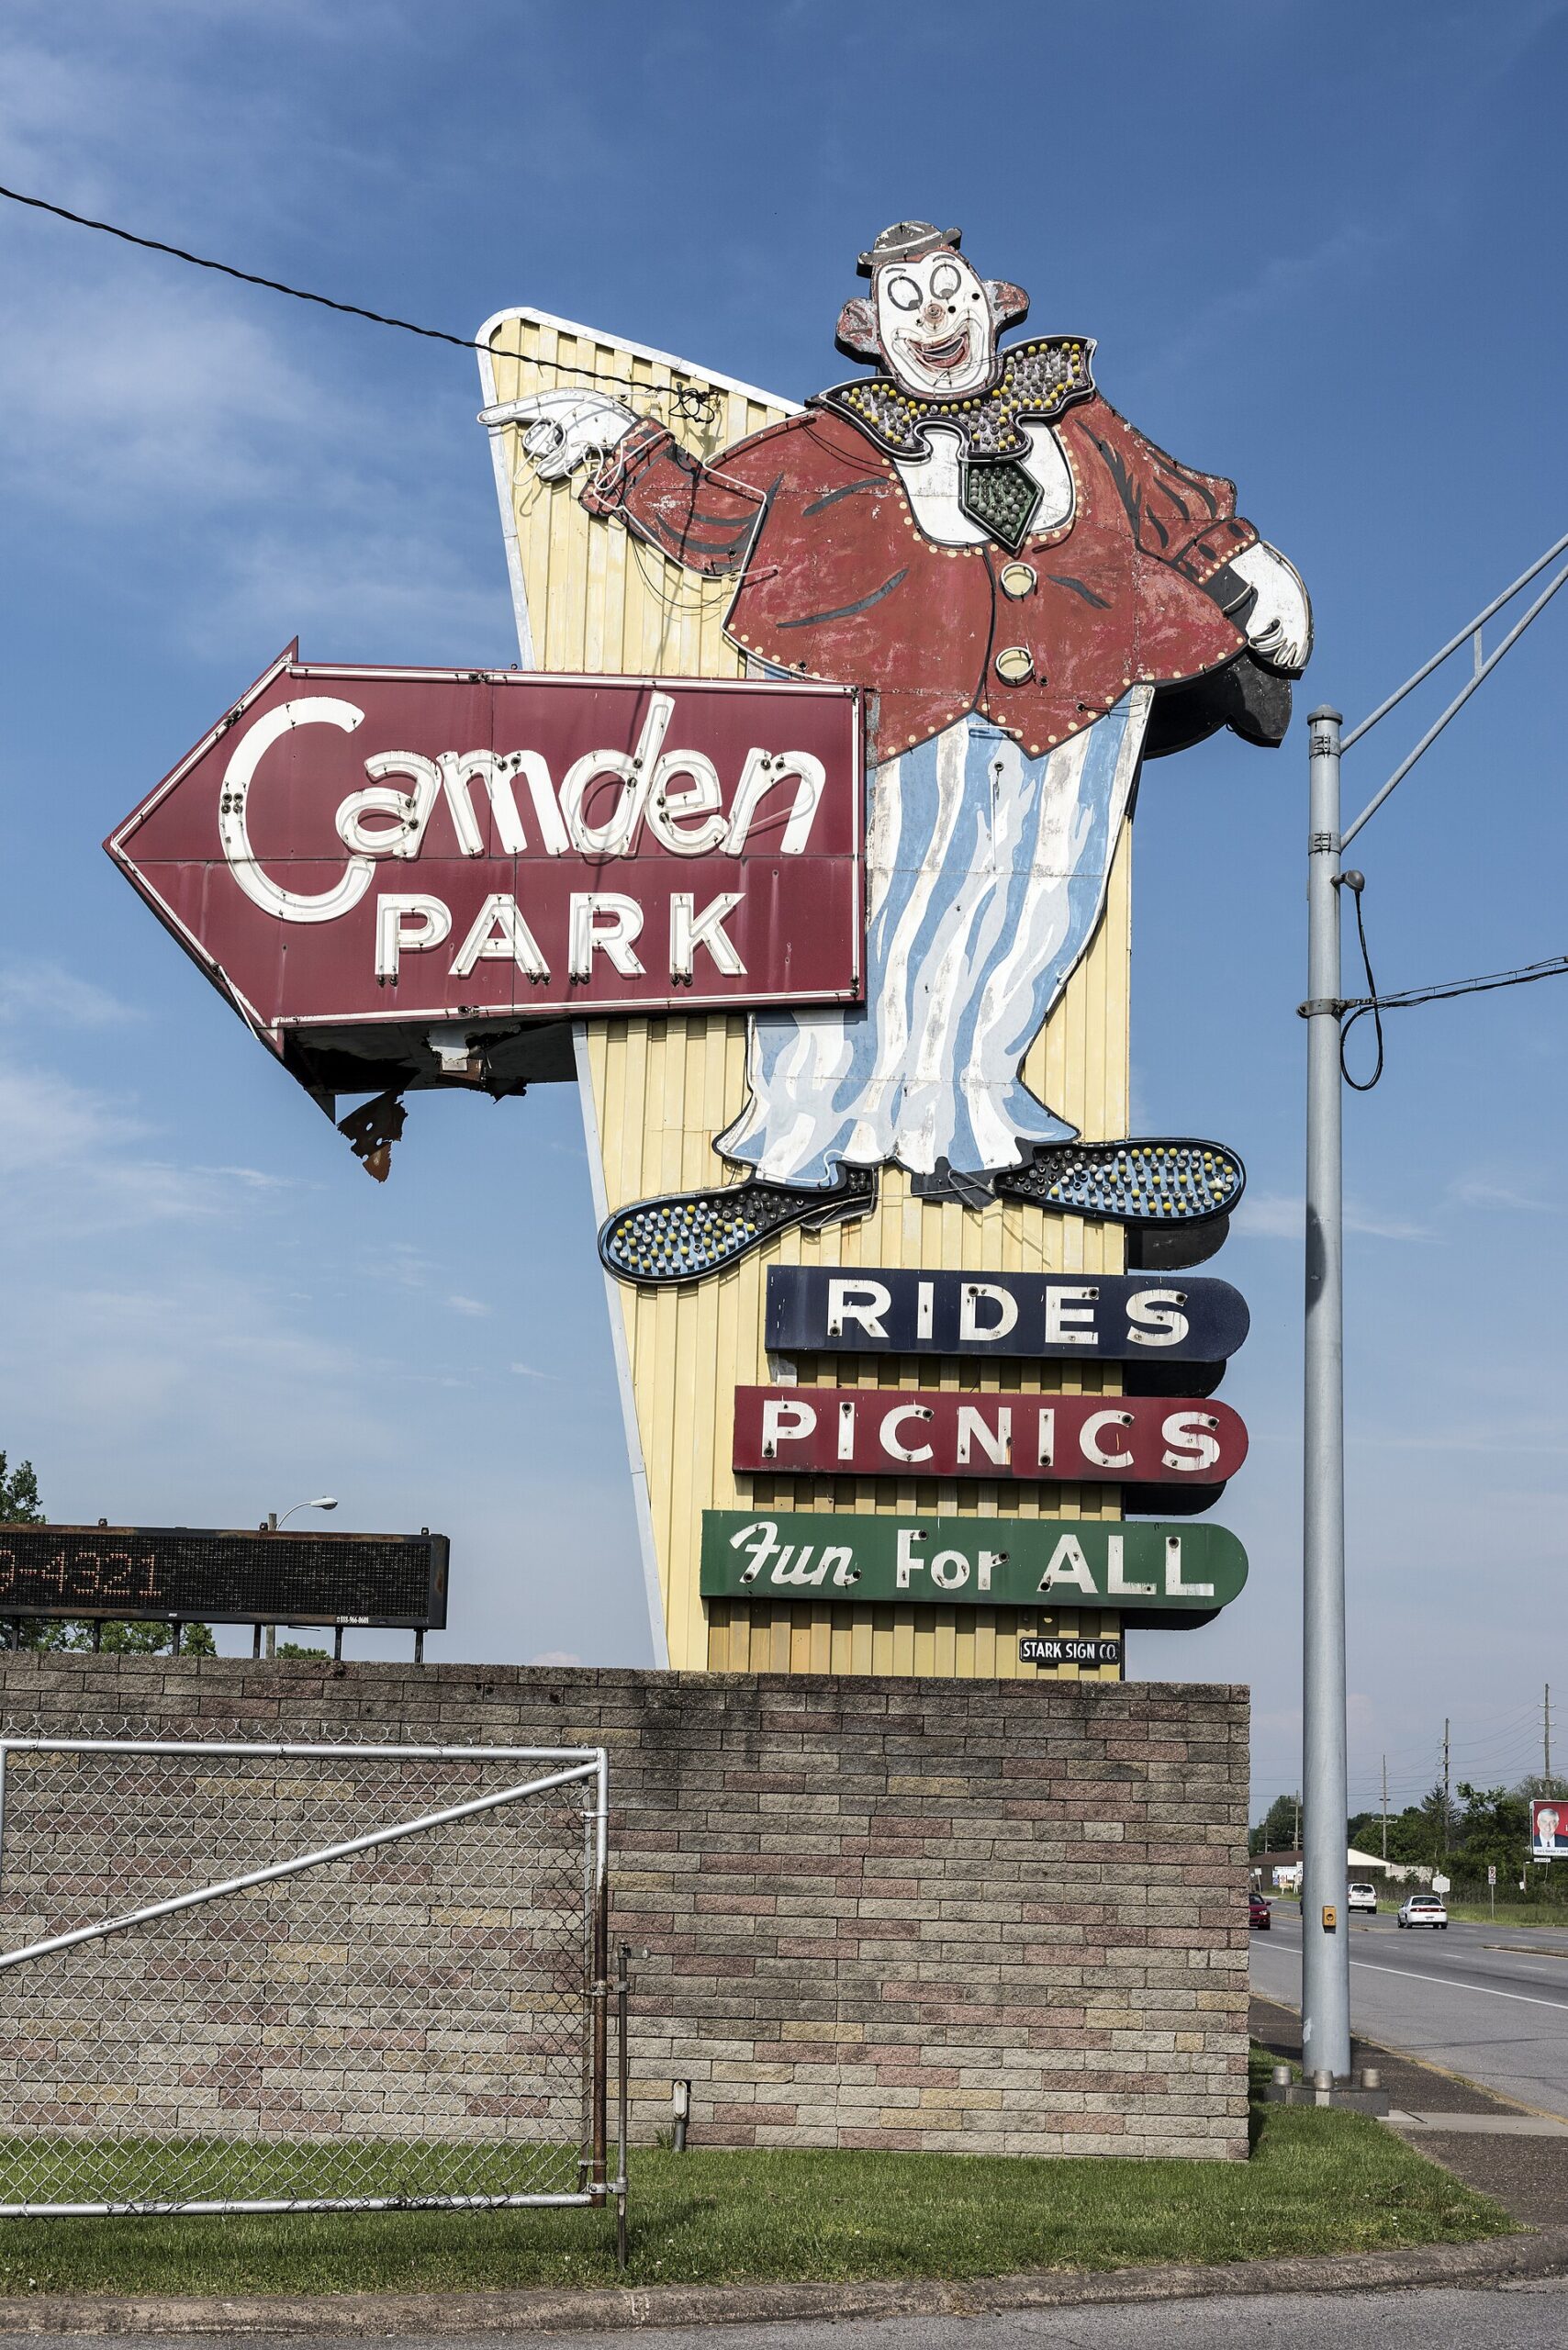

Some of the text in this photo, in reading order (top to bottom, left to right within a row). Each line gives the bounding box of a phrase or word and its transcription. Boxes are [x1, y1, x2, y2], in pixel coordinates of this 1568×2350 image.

[219, 690, 827, 923] Camden
[375, 892, 747, 978] PARK
[827, 1278, 1190, 1348] RIDES
[761, 1400, 1221, 1472] PICNICS
[729, 1520, 1215, 1597] Fun For ALL
[1023, 1641, 1062, 1658] STARK
[1065, 1642, 1095, 1660] SIGN
